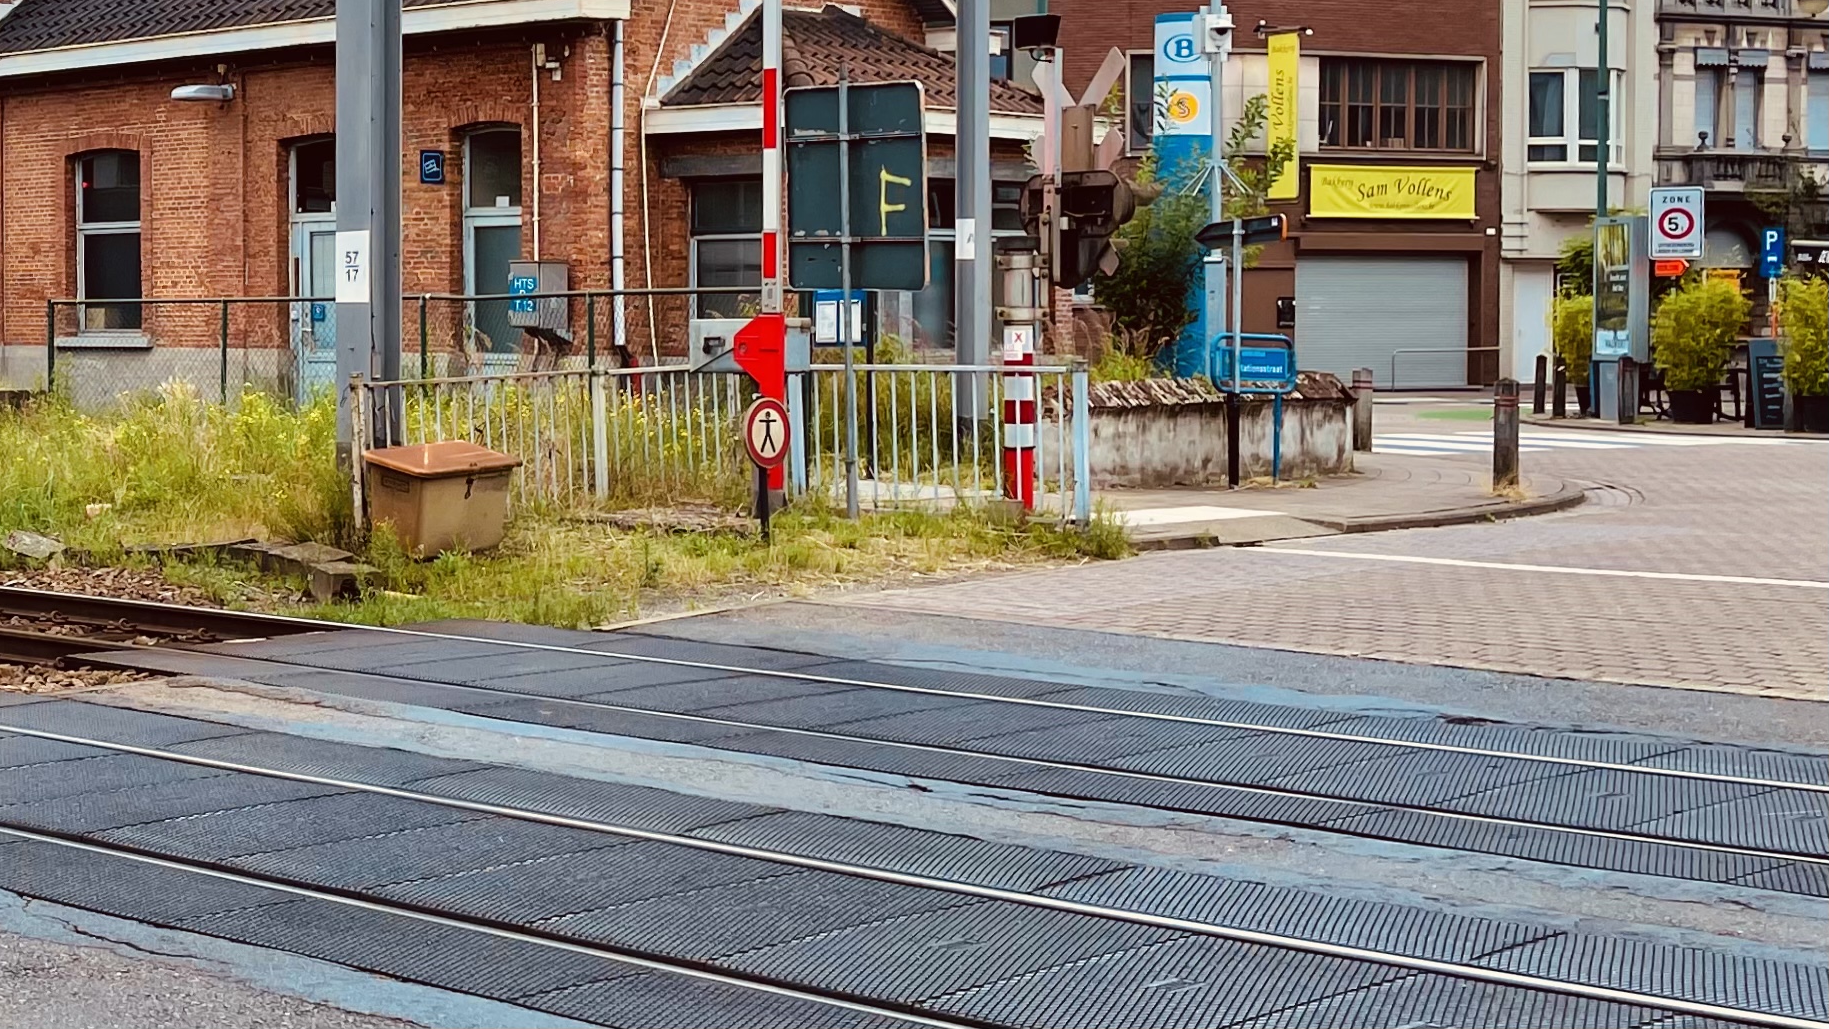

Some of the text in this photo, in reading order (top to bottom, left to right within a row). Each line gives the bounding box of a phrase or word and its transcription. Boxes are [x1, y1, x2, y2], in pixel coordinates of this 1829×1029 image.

[1271, 69, 1285, 131] Vollens
[1357, 176, 1453, 202] Sam Vollens
[880, 164, 912, 237] F
[1766, 231, 1778, 250] P
[345, 251, 359, 264] 57
[346, 269, 359, 282] 17
[514, 278, 534, 289] HTS
[1240, 363, 1283, 374] tationsstraat
